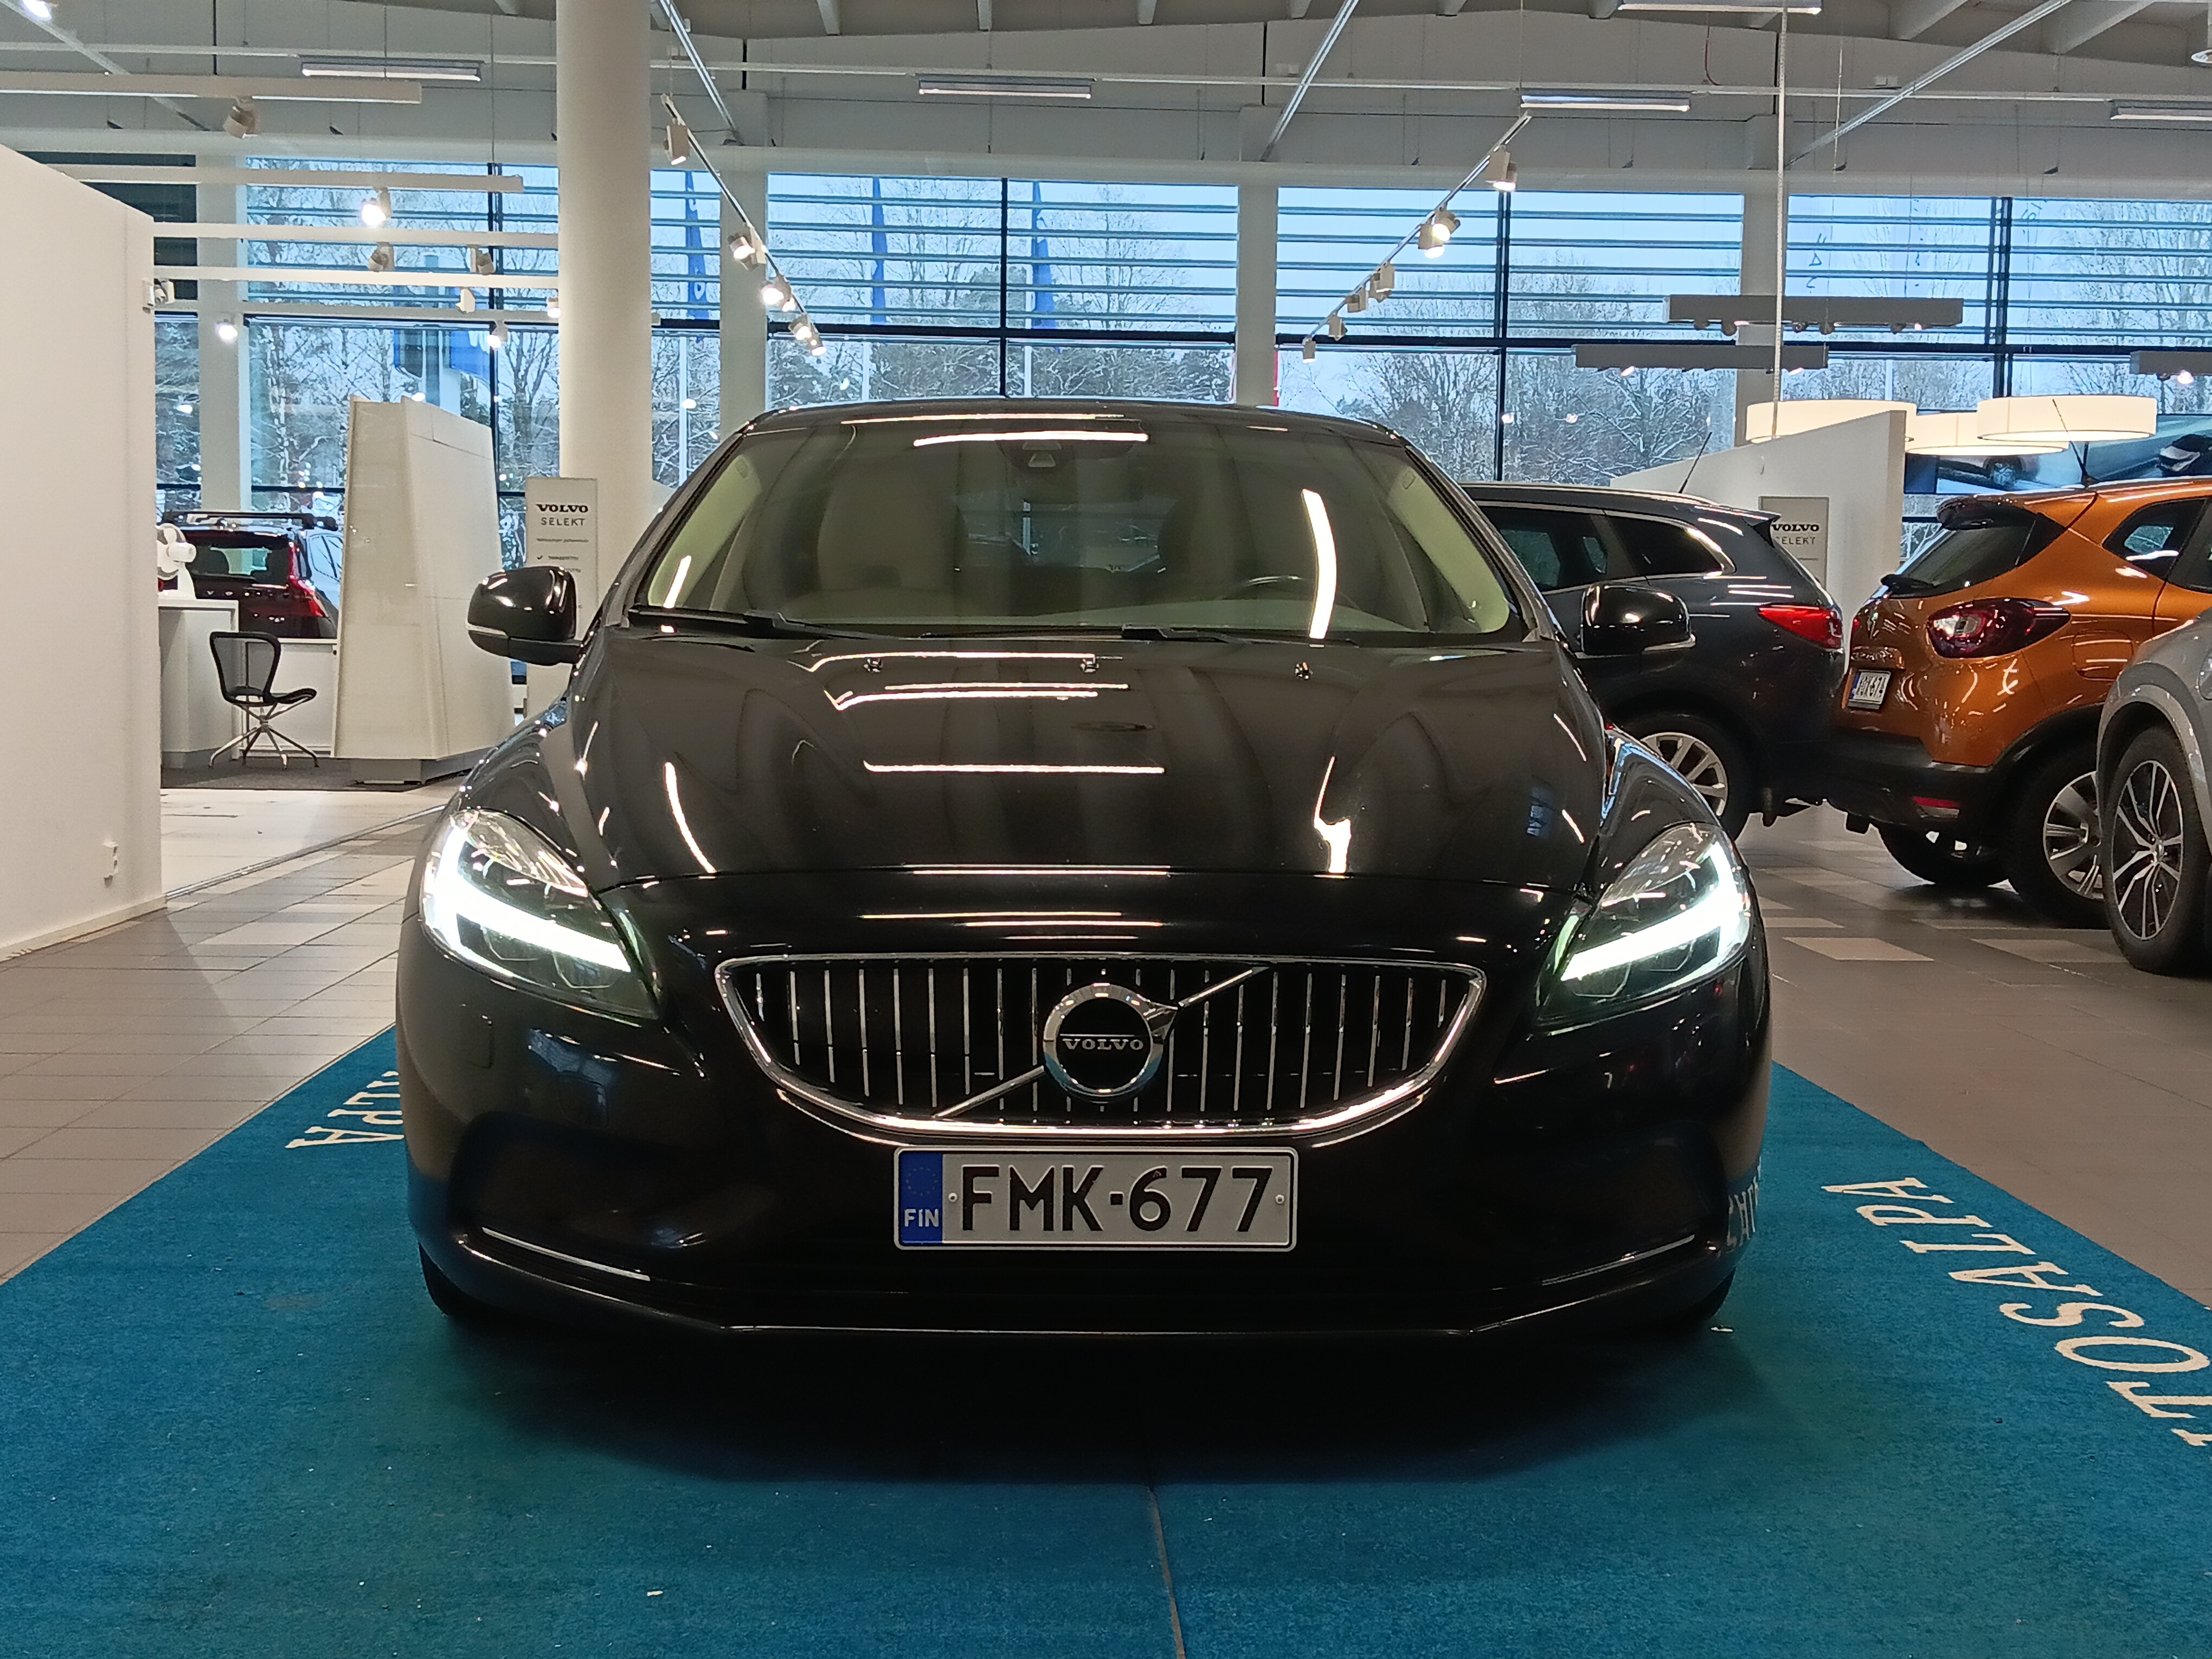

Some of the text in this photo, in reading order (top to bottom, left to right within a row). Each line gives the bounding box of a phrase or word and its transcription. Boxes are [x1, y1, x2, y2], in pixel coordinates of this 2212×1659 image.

[536, 504, 589, 513] VOLVO
[540, 517, 586, 526] SELEKT
[1771, 524, 1819, 532] VOLVO
[1776, 536, 1816, 545] ELEKT
[1062, 1038, 1144, 1051] VOLVO
[960, 1165, 1274, 1232] FMK-677
[904, 1208, 940, 1227] FIN
[1821, 1176, 2212, 1446] TOSALPA
